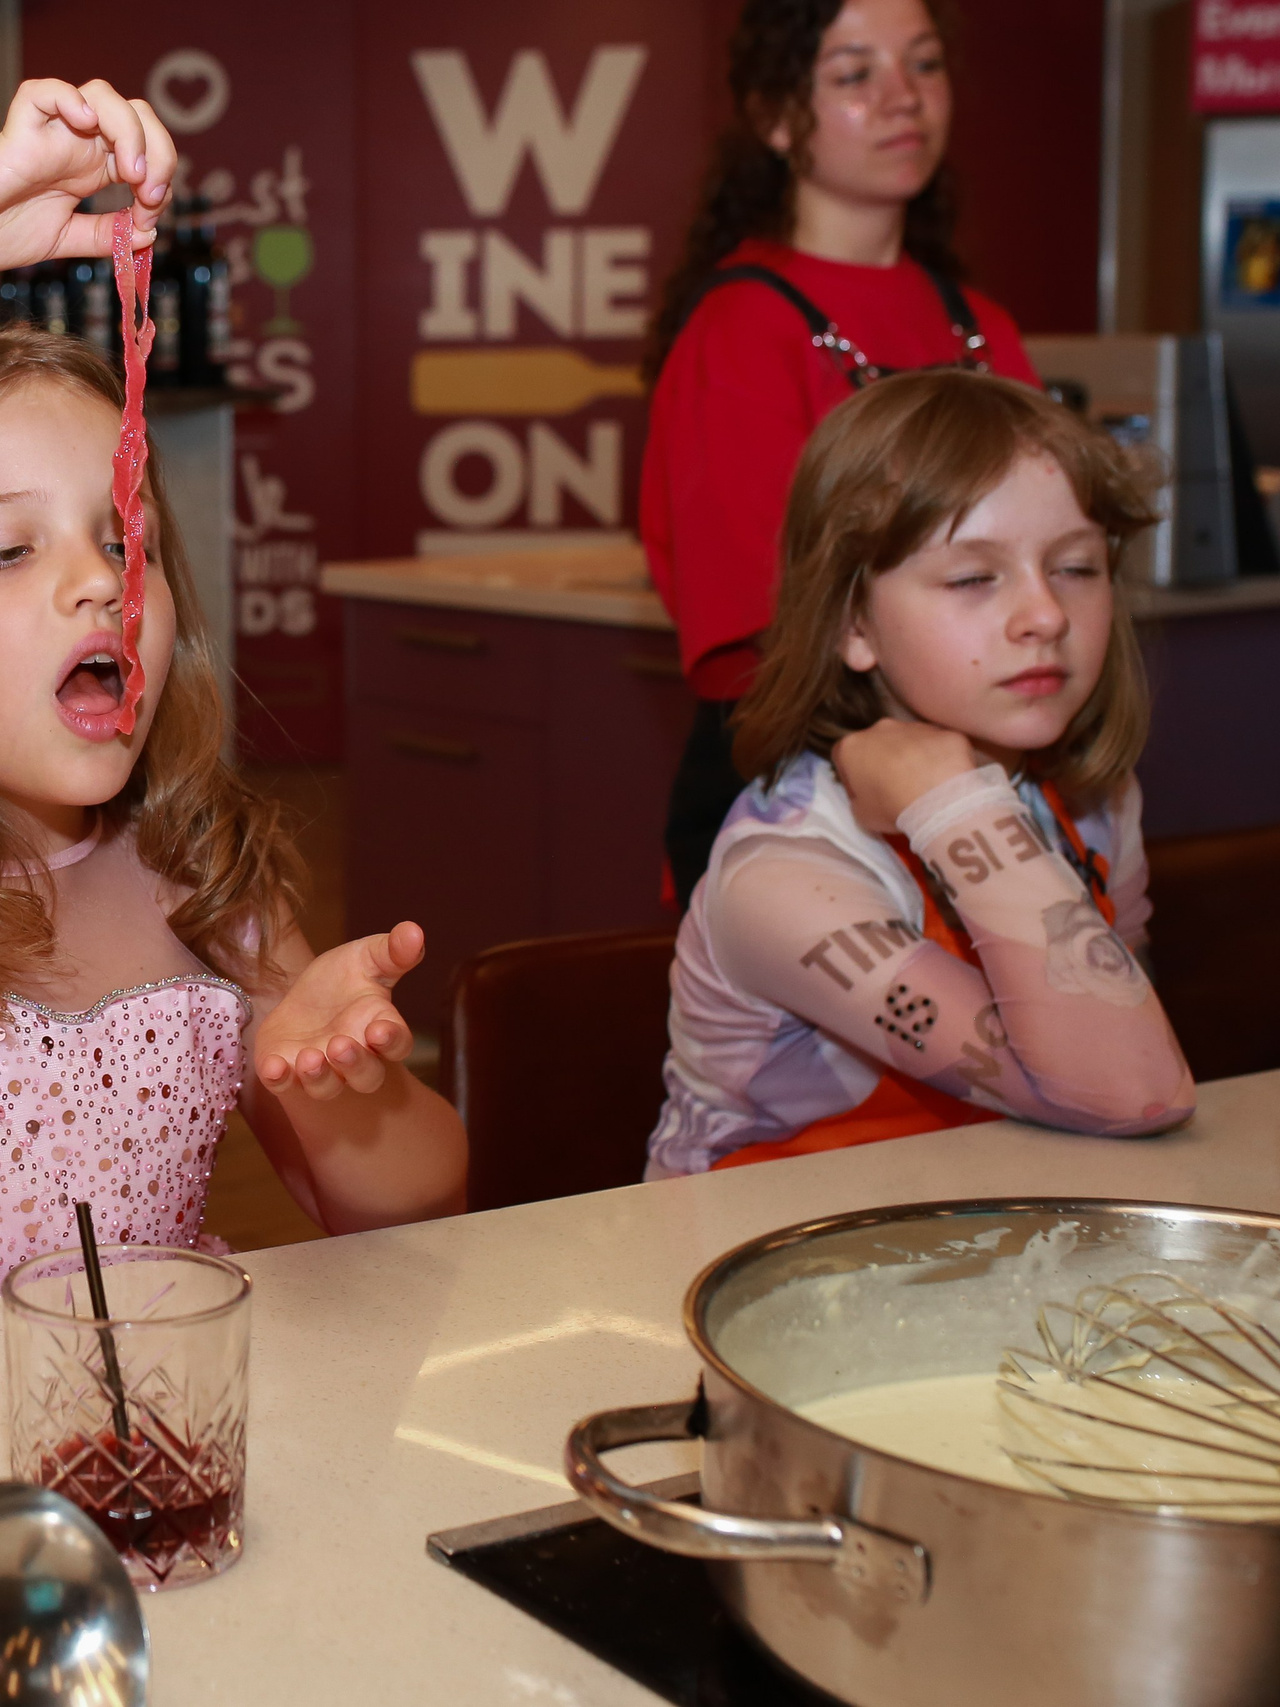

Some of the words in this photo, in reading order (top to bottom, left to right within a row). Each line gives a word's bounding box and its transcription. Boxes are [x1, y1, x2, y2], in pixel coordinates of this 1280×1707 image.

[411, 45, 649, 217] W
[419, 227, 652, 340] INE
[419, 421, 621, 529] ON
[874, 983, 939, 1052] IS
